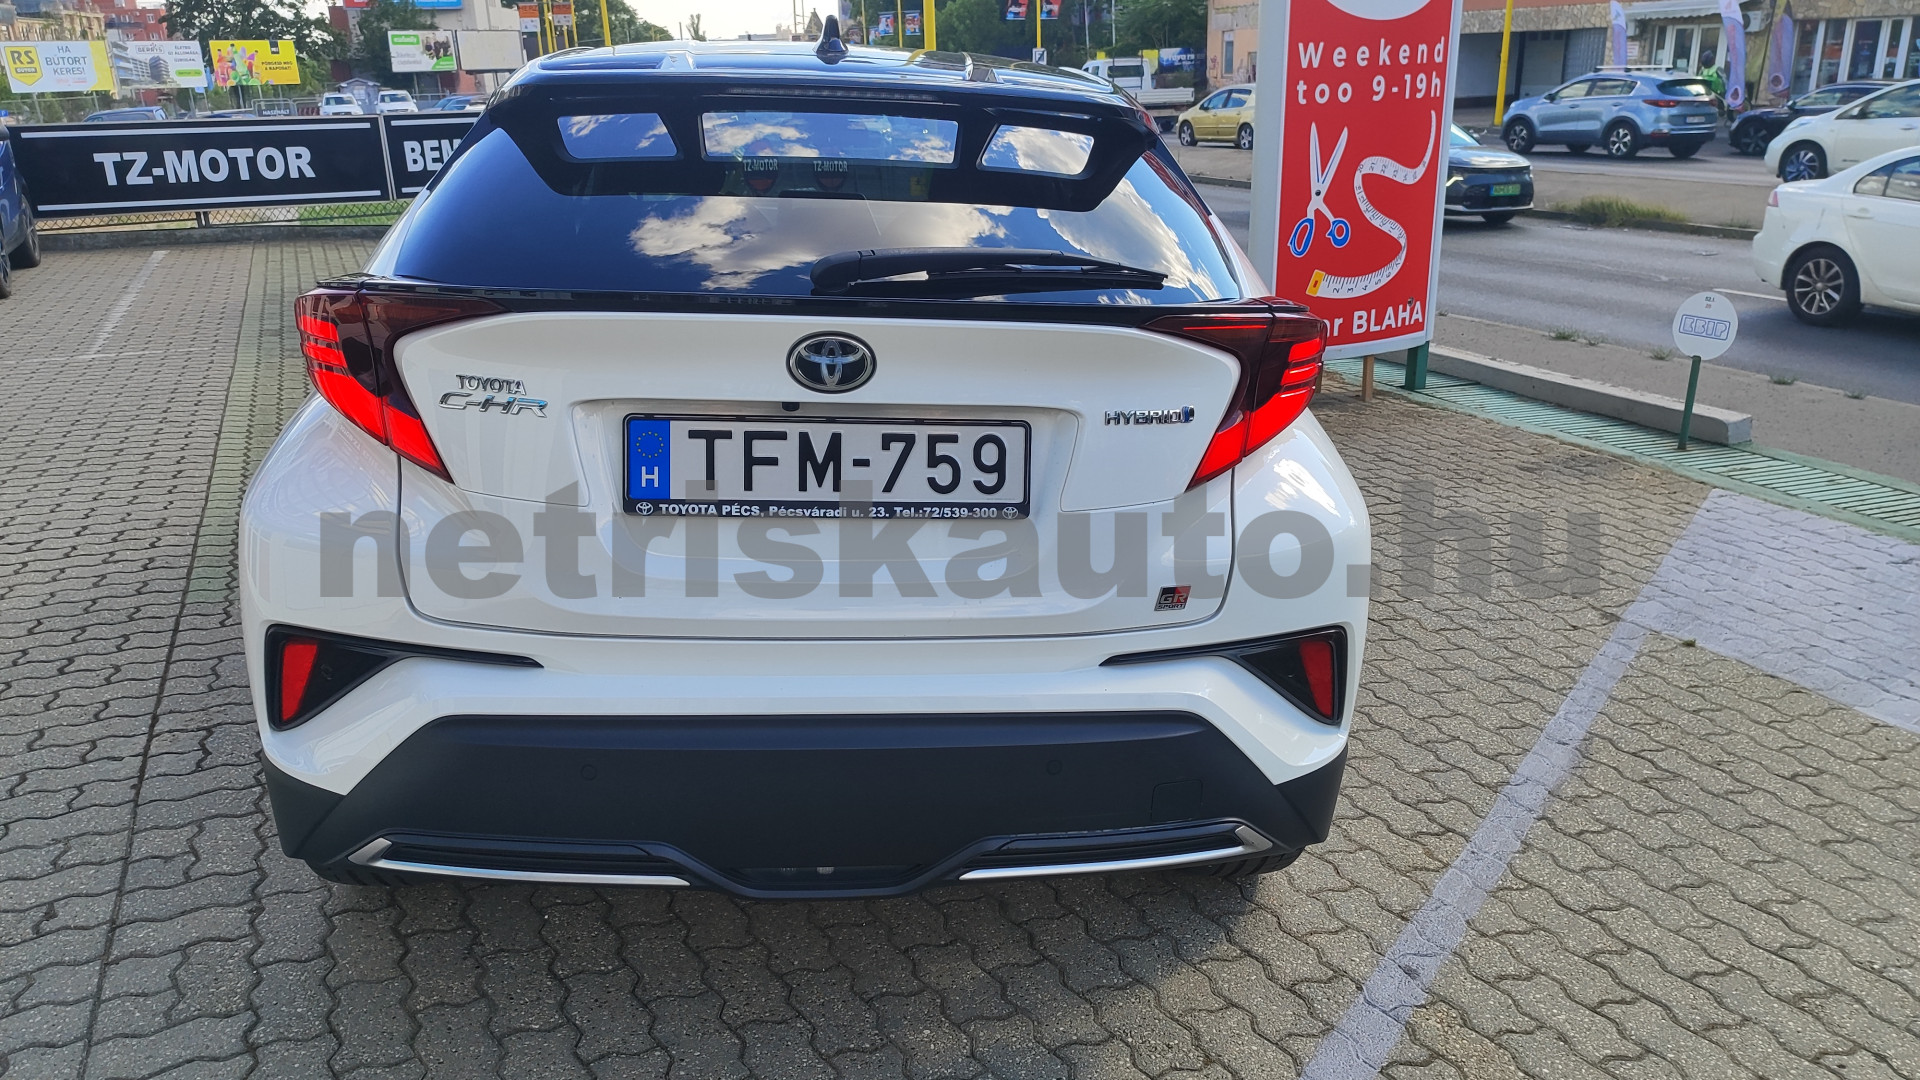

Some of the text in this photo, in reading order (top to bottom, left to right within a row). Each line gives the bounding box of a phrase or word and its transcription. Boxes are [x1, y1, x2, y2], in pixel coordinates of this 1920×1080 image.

[10, 50, 35, 65] RS
[57, 45, 71, 54] HA
[1298, 36, 1445, 69] Weekend
[45, 54, 87, 66] BÚTORT
[53, 67, 86, 76] KERES!
[1296, 79, 1352, 105] too
[93, 146, 316, 187] TZ-MOTOR
[742, 158, 778, 172] TZ-MOTOR
[812, 160, 848, 172] TZ-MOTOR
[1352, 301, 1423, 335] BLAHA
[456, 374, 527, 396] TOYOTA
[438, 391, 549, 418] C-HR
[1105, 409, 1181, 426] HYBRID
[640, 430, 1007, 495] H TFM-759
[659, 502, 998, 518] TOYOTA PÉCS, Pécsváradi u. 23. Tel.:72/539-300
[1160, 593, 1187, 604] GR
